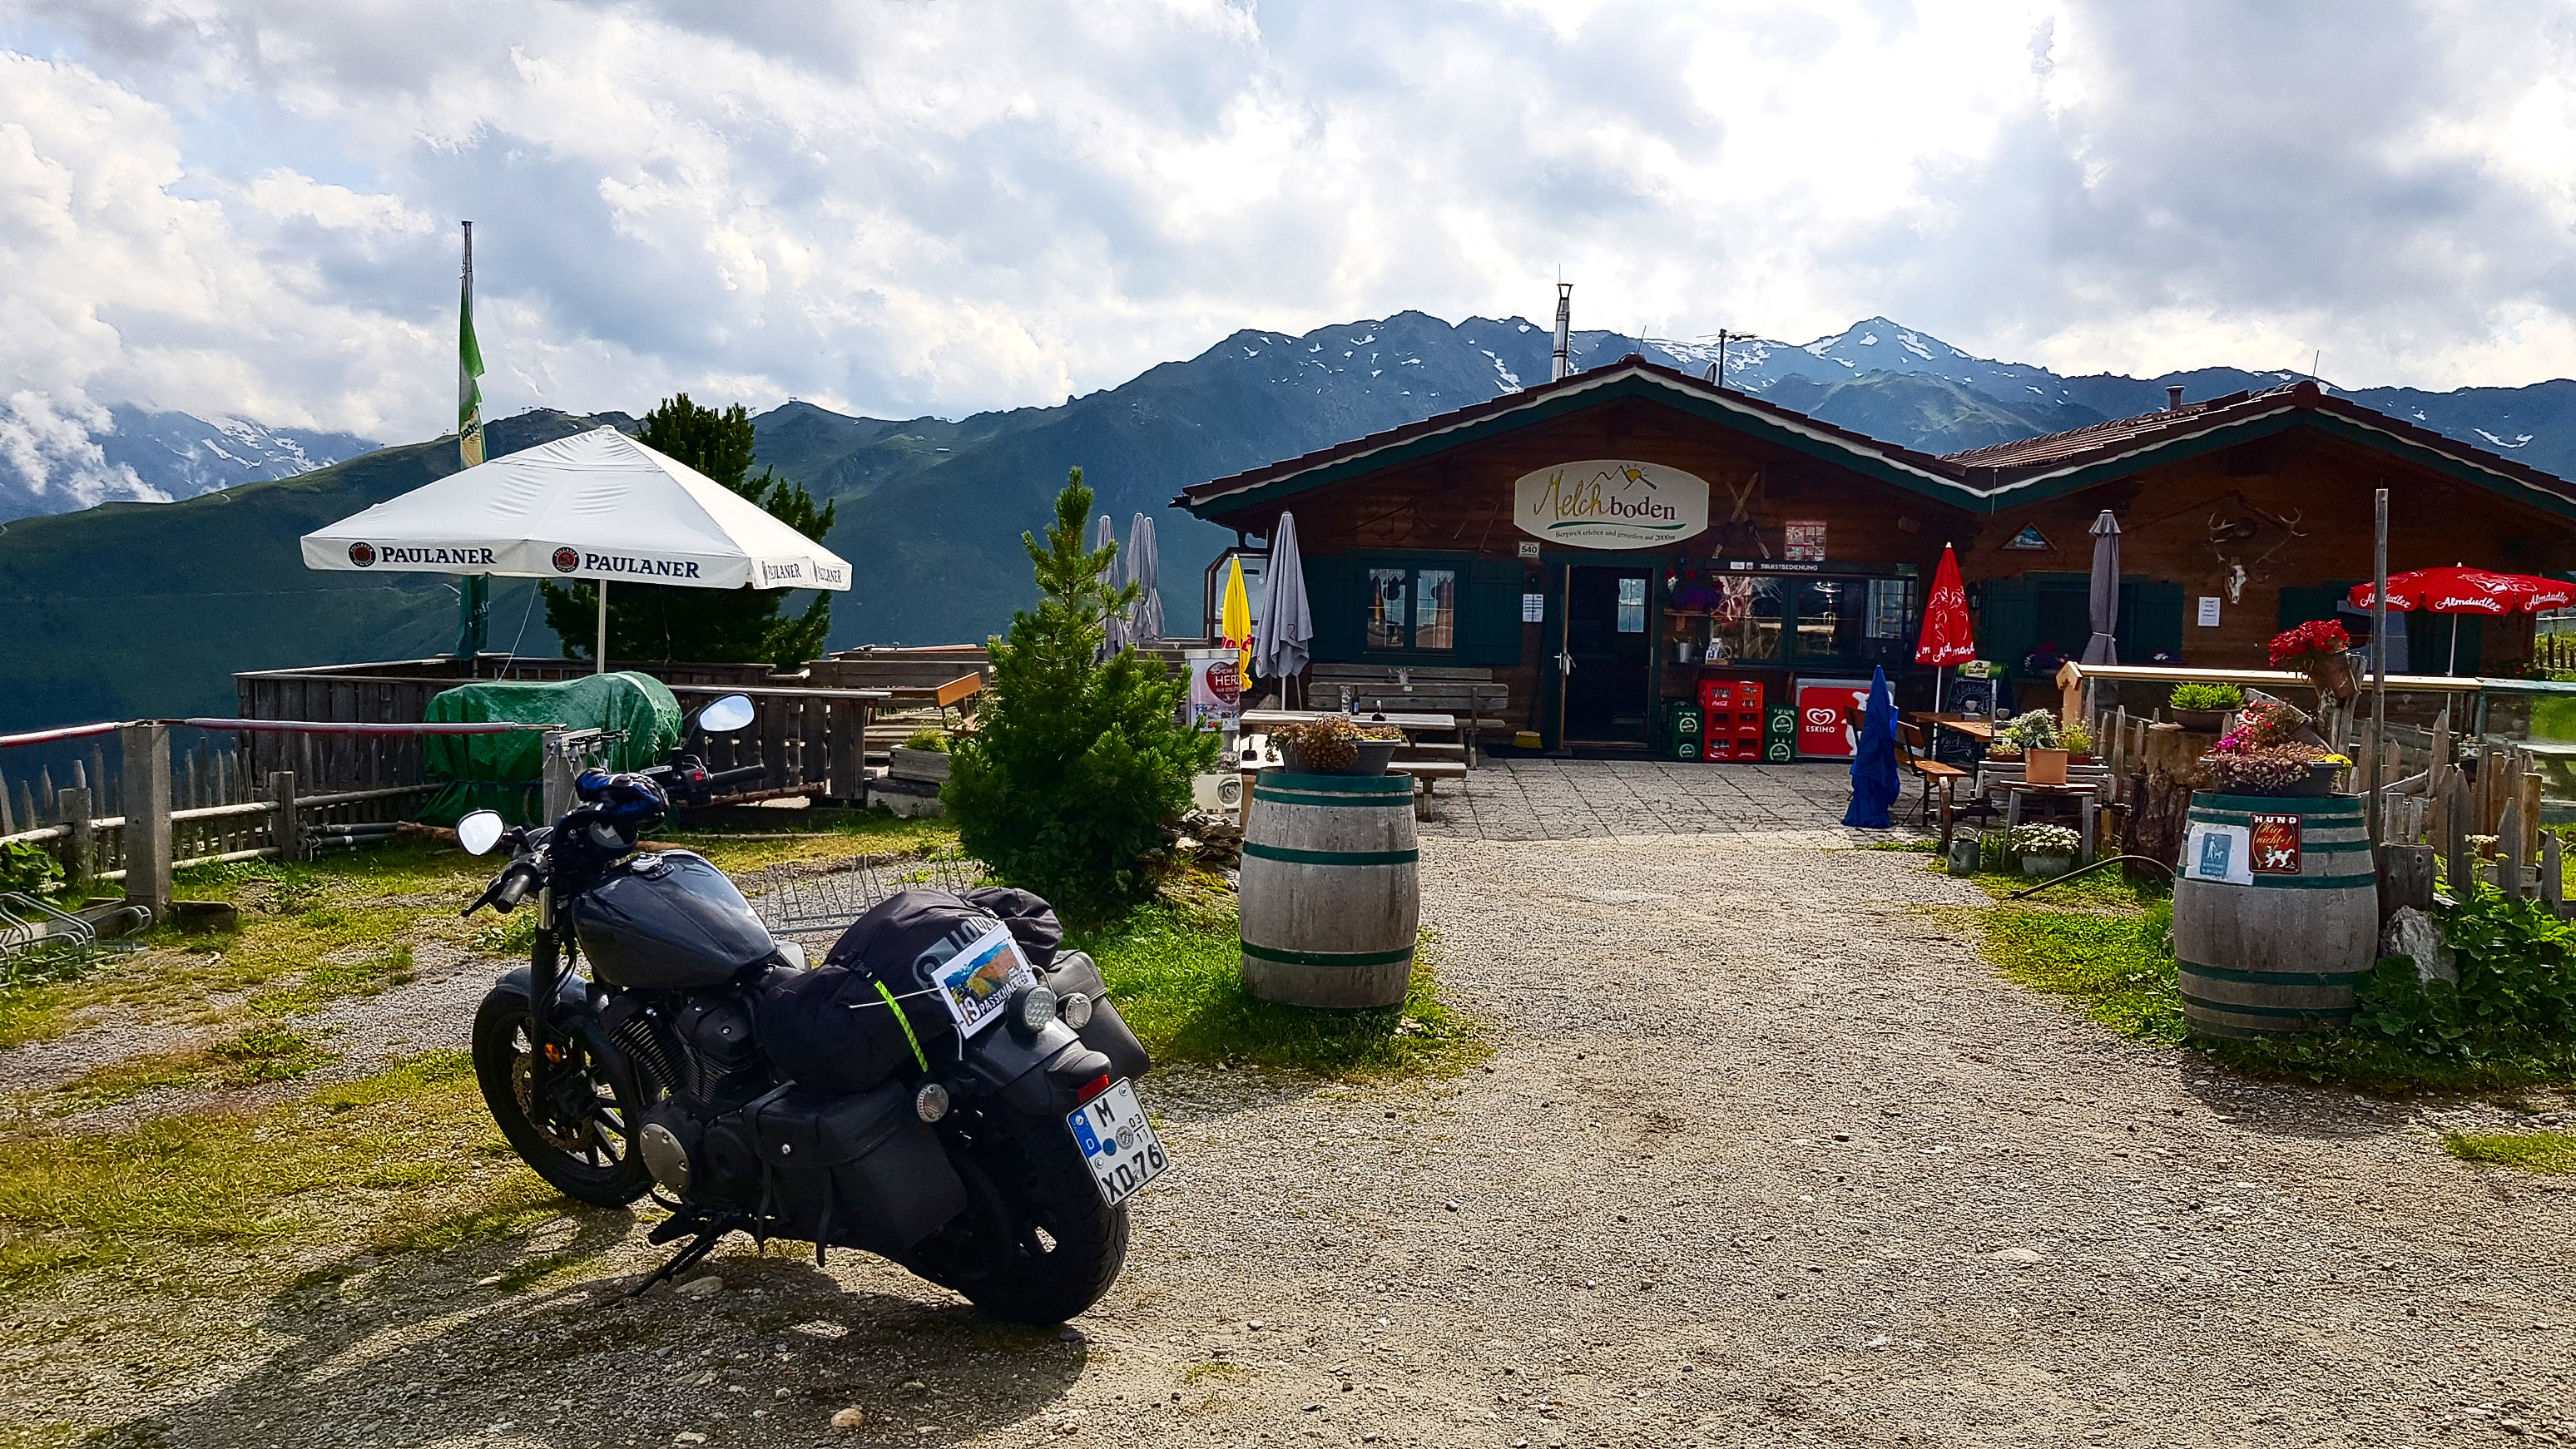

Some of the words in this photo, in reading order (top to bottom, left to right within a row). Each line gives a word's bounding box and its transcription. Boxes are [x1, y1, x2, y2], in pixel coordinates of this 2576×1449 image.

[379, 546, 498, 565] PAULANER
[1521, 546, 1538, 554] 540
[584, 553, 701, 579] PAULANER
[2435, 596, 2502, 612] Almdudler
[2254, 815, 2297, 824] HUND
[2261, 823, 2284, 837] Hier
[959, 996, 982, 1026] 19
[1093, 1097, 1116, 1128] M
[1128, 1113, 1142, 1128] 03
[1137, 1129, 1149, 1143] 11
[1085, 1138, 1095, 1150] D
